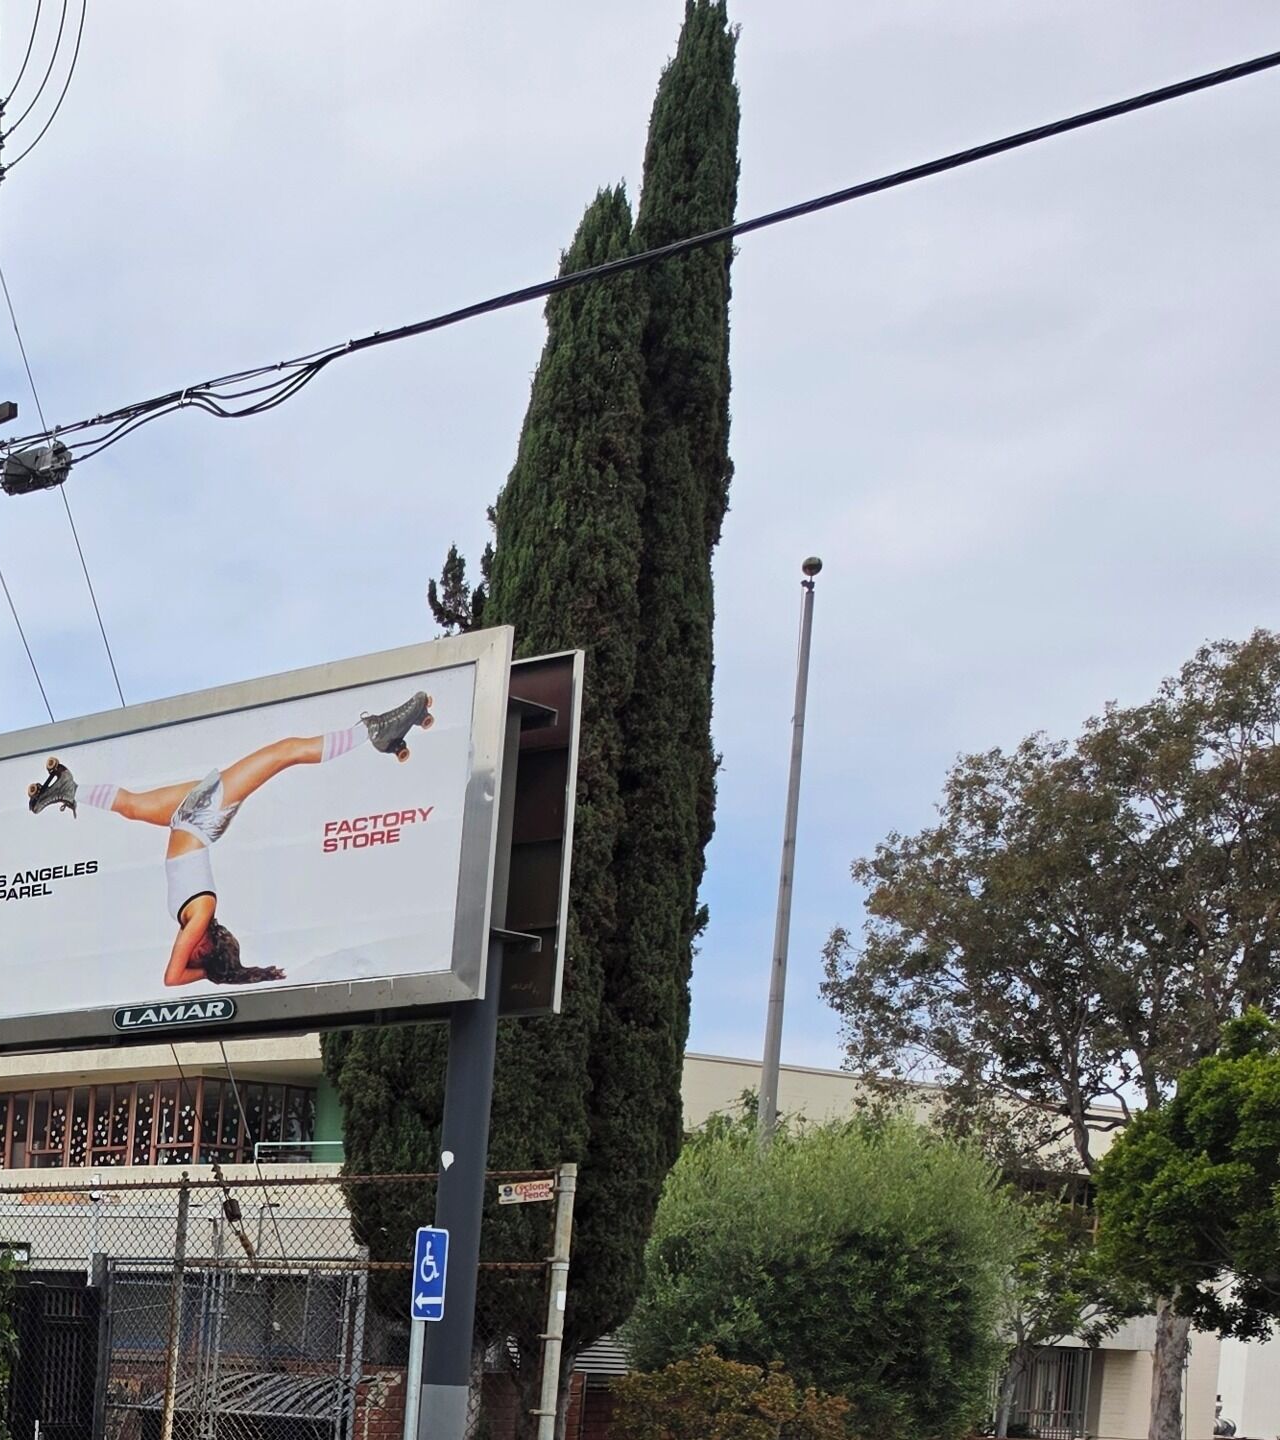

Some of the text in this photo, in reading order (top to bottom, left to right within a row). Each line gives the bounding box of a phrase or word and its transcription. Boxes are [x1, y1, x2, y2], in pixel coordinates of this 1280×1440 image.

[324, 806, 434, 837] FACTORY
[323, 828, 401, 853] STORE
[11, 860, 98, 886] ANGELES
[121, 1001, 225, 1026] LAMAR
[514, 1182, 550, 1196] Cyclone
[523, 1190, 550, 1201] Fence
